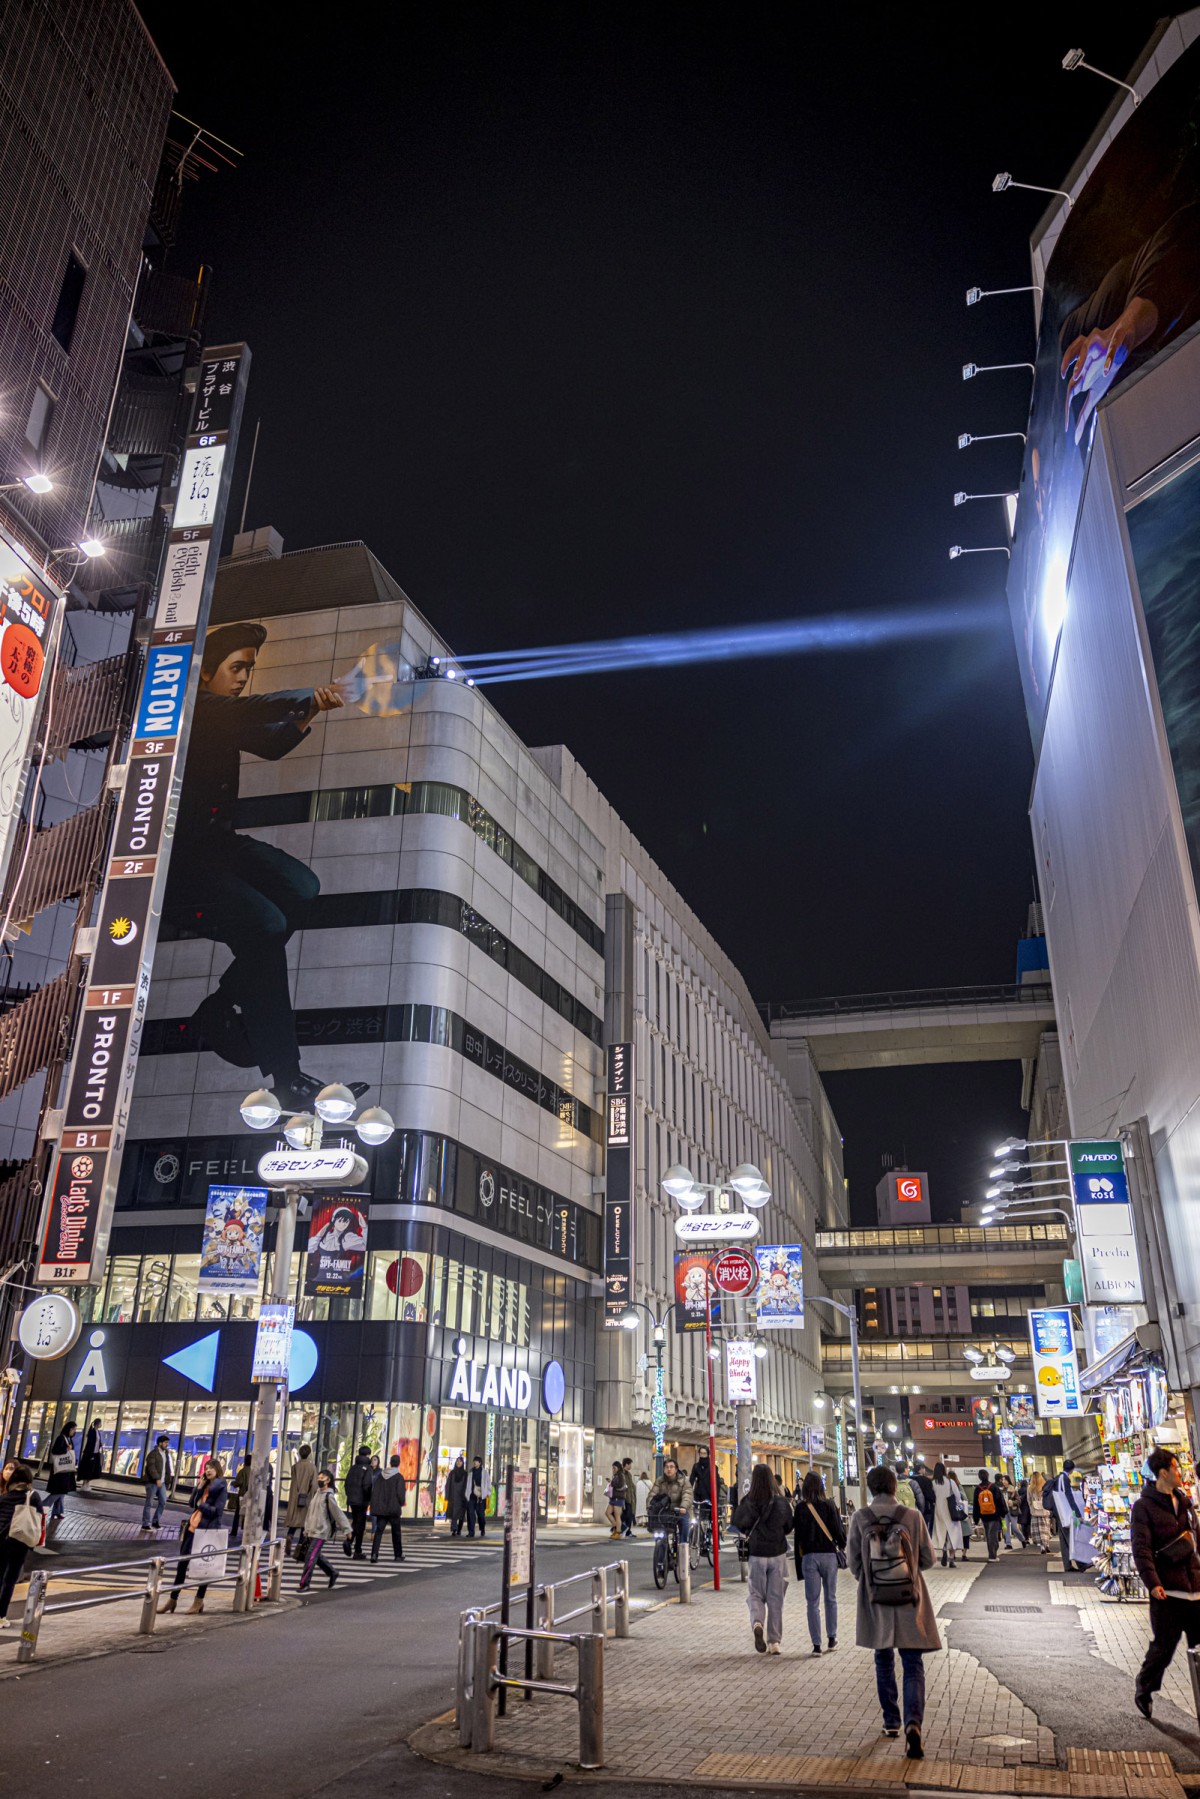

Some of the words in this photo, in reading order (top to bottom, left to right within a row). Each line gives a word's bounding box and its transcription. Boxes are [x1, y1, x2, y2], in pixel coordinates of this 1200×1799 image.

[195, 362, 219, 431] ブラザービル
[199, 436, 217, 446] 6F
[183, 531, 199, 540] 5F
[185, 546, 202, 577] eight
[171, 547, 188, 592] eyelash
[165, 602, 178, 624] nail
[165, 632, 182, 642] 4F
[144, 654, 183, 732] ARTON
[145, 742, 164, 754] 3F
[129, 763, 159, 850] PRONTO
[124, 862, 143, 874] 2F
[102, 991, 121, 1004] 1F
[83, 1016, 116, 1119] PRONTO
[614, 1047, 624, 1090] シネクイント
[76, 1133, 97, 1147] B1
[264, 1158, 348, 1171] 渋谷センター街
[1078, 1154, 1117, 1162] SHISEIDO
[67, 1180, 93, 1213] Lad's
[1091, 1190, 1114, 1199] KOSÉ
[680, 1220, 754, 1232] 渋谷センター街
[57, 1216, 88, 1259] Dining
[53, 1268, 76, 1277] B1F
[719, 1266, 749, 1281] 消火栓
[729, 1357, 750, 1368] Happy
